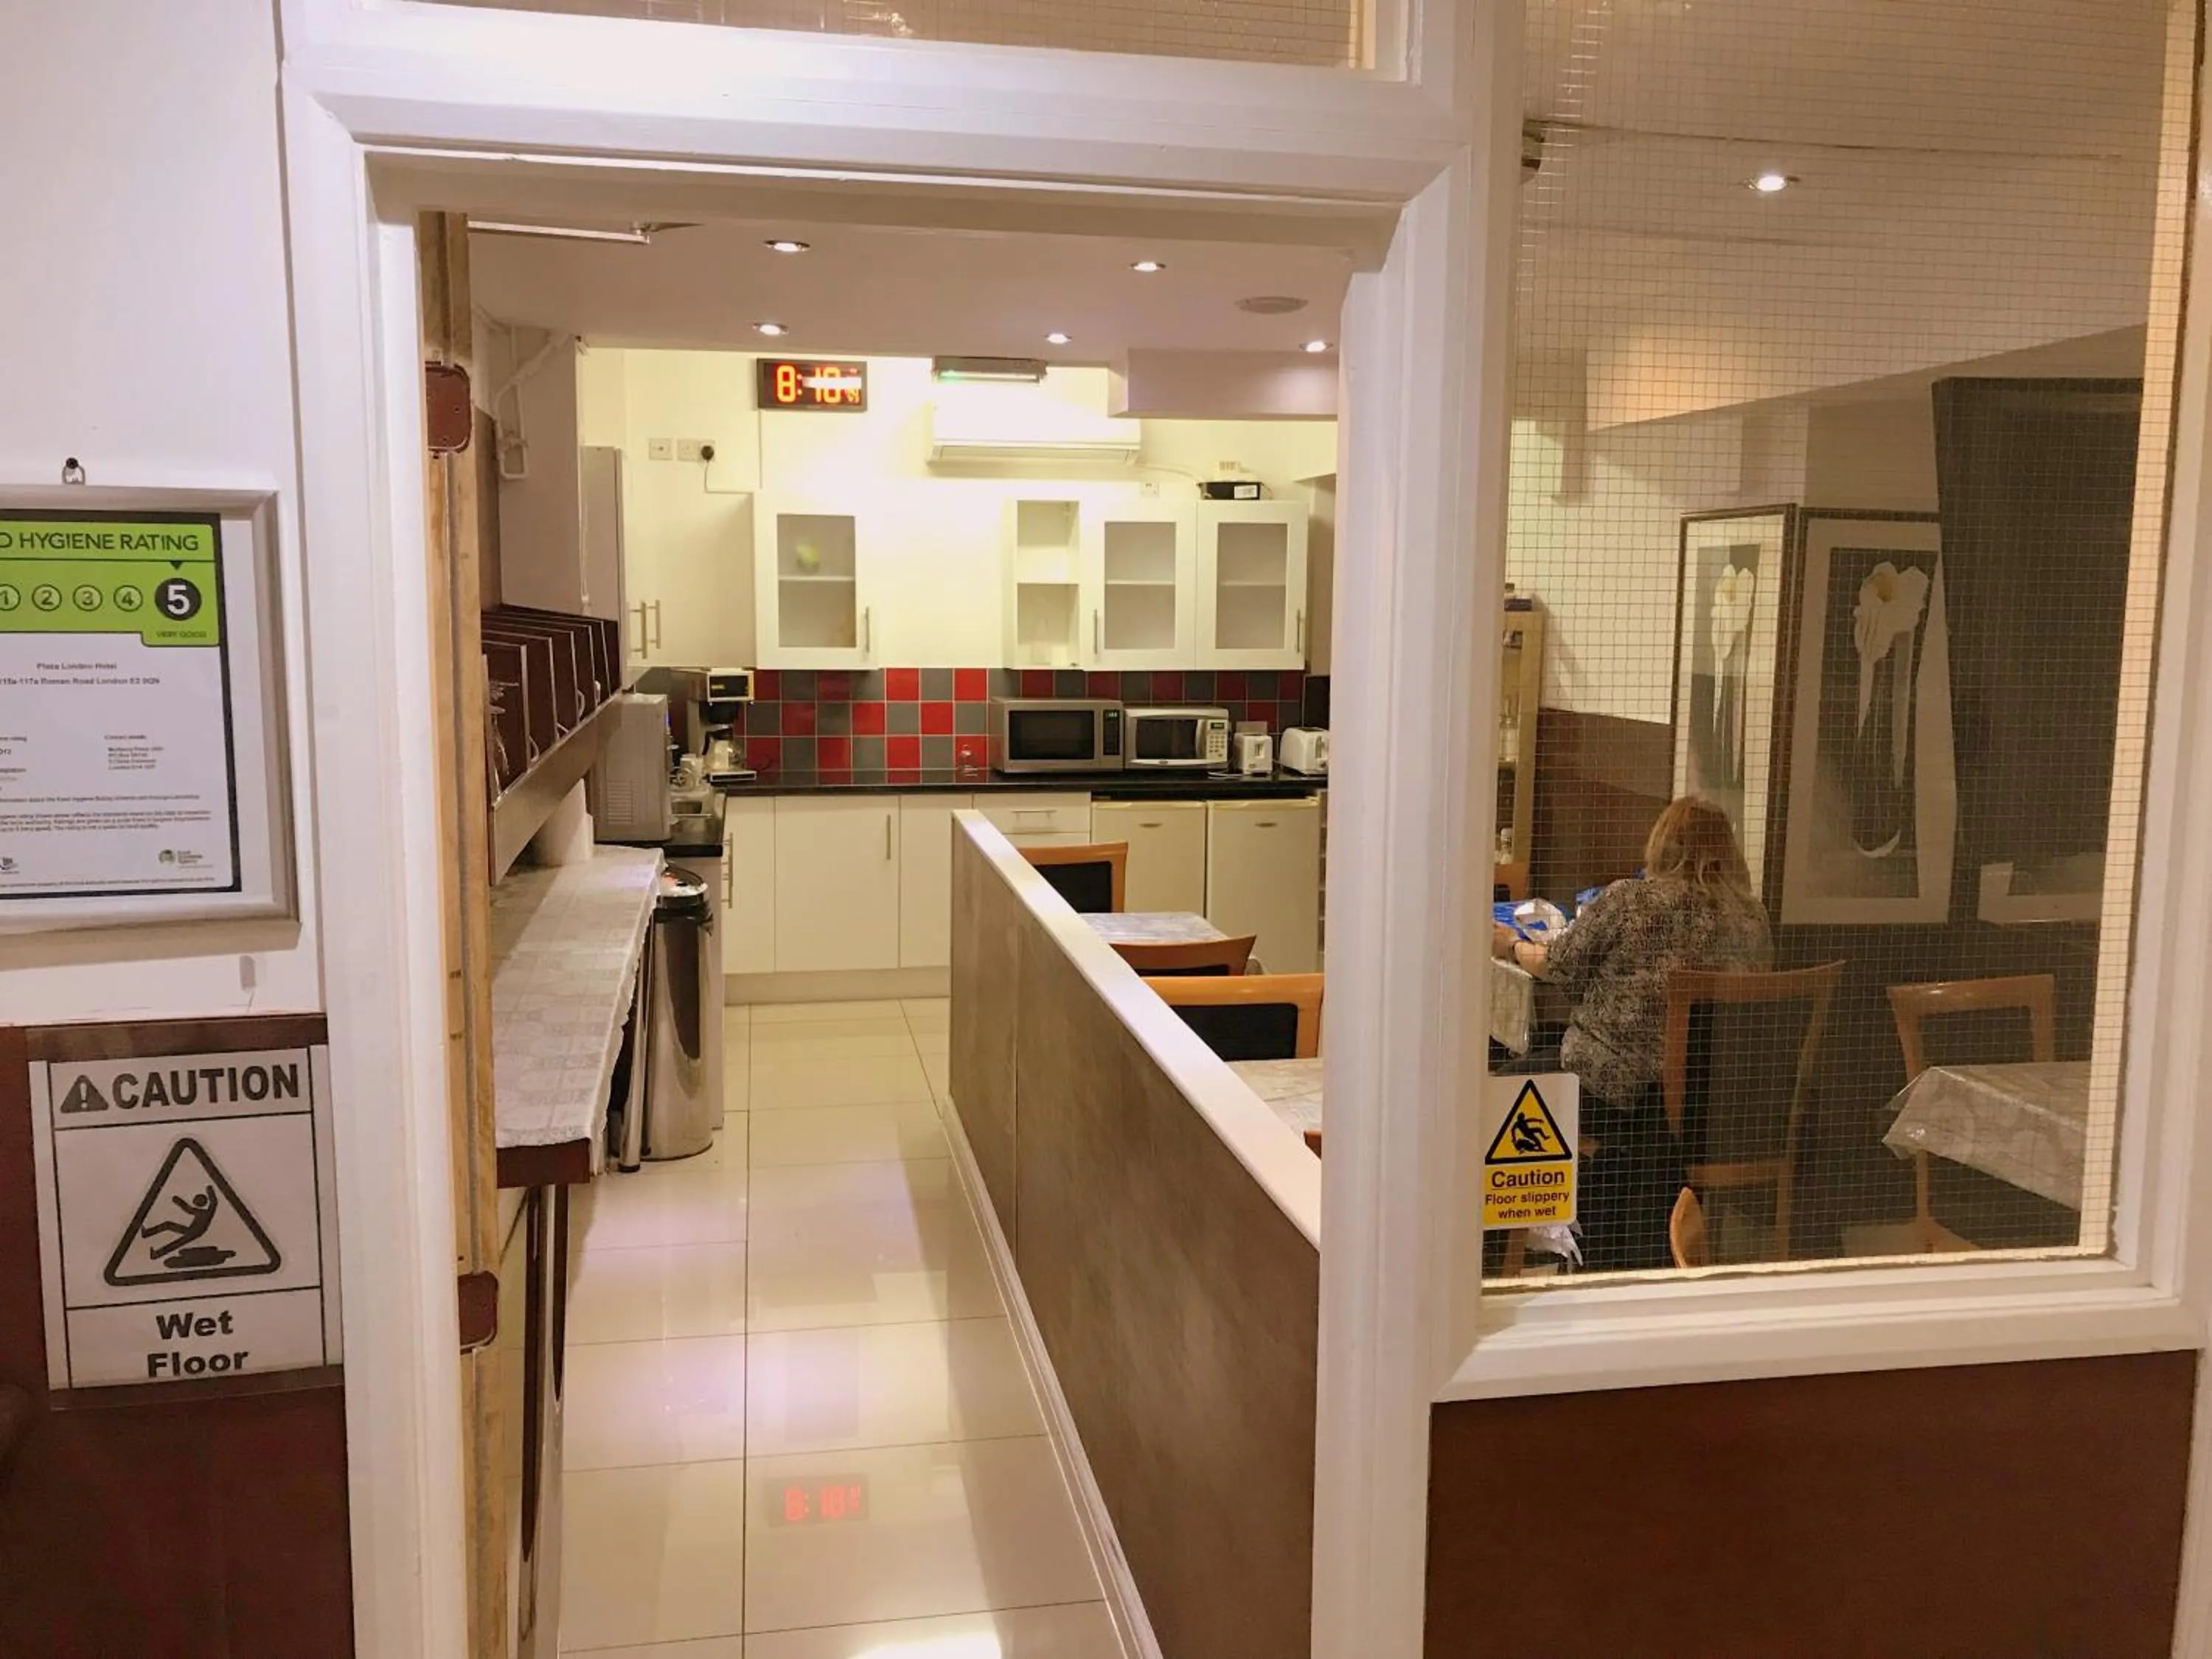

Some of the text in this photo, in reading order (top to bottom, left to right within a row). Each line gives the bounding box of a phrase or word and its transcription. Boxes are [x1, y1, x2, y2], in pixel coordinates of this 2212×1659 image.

[19, 533, 114, 550] HYGIENE
[120, 535, 198, 551] RATING
[41, 590, 53, 605] 2
[82, 591, 94, 605] 3
[121, 591, 134, 606] 4
[167, 584, 190, 615] 5
[112, 1063, 299, 1110] CAUTION
[1492, 1169, 1565, 1188] Caution
[1486, 1191, 1569, 1205] Floor slippery
[1498, 1206, 1556, 1219] when wet
[156, 1310, 234, 1340] Wet
[147, 1351, 249, 1378] Floor
